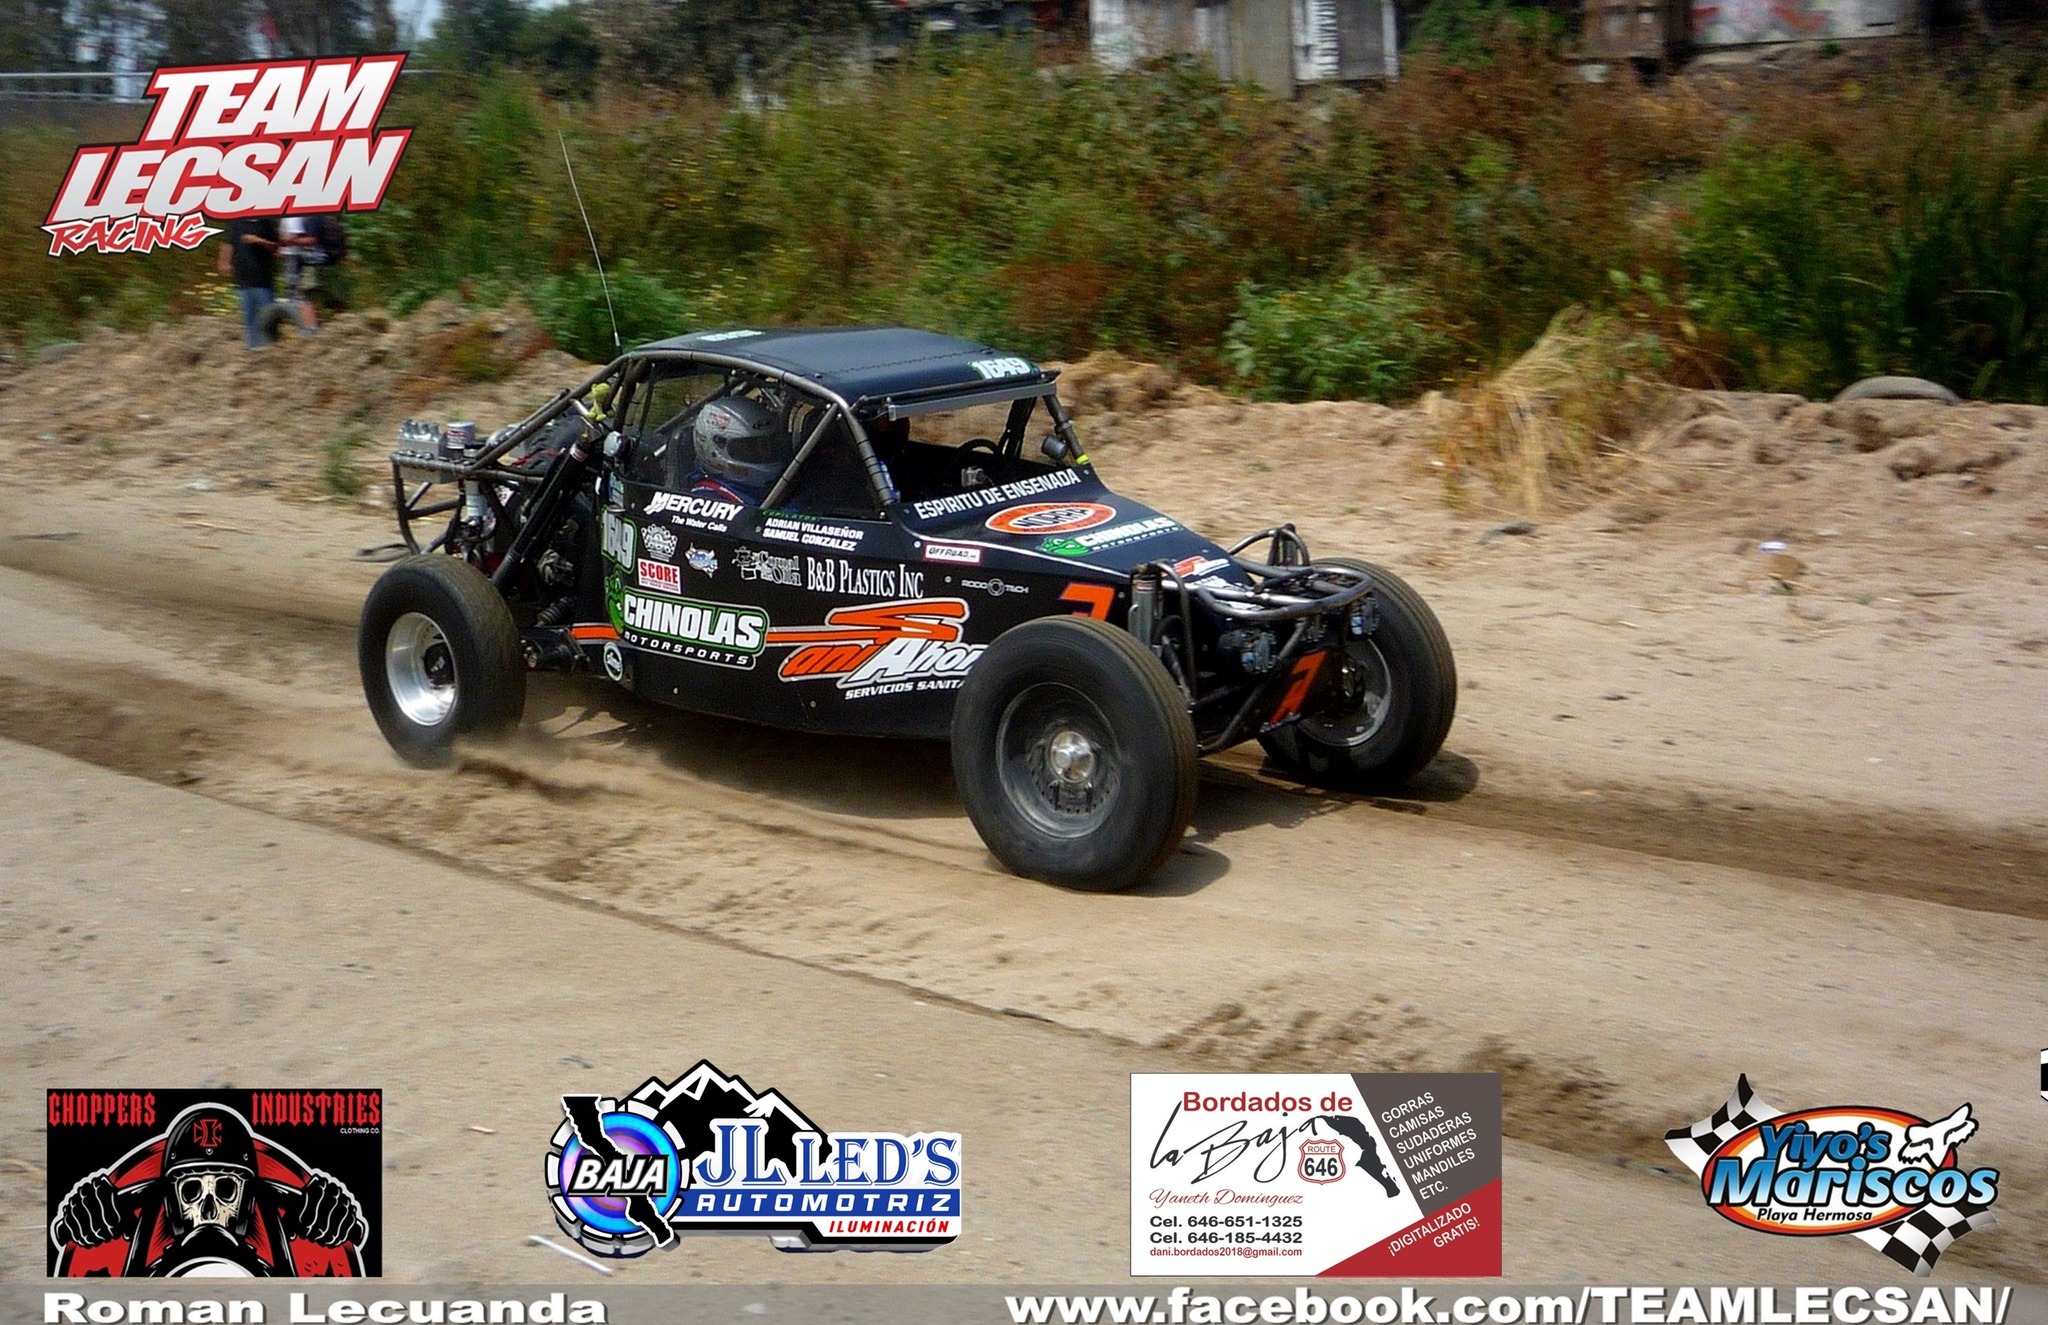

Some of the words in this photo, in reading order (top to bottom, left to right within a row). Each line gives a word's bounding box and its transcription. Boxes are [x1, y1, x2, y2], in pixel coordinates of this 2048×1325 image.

[971, 358, 1032, 379] 1649
[913, 494, 984, 520] ESPIRITU
[983, 487, 1002, 505] DE
[1000, 468, 1082, 500] ENSENADA
[643, 491, 743, 521] MERCURY
[671, 515, 685, 525] The
[707, 521, 728, 533] Calls
[765, 518, 801, 531] ADRIAN
[801, 522, 864, 540] VILLASEÑOR
[762, 528, 800, 542] SAMUEL
[801, 535, 858, 551] GONZALEZ
[640, 561, 679, 584] SCORE
[806, 556, 835, 593] B&B
[623, 593, 764, 649] CHINOLAS
[624, 631, 750, 665] MOTORSPORTS
[844, 682, 914, 700] SERVICIOS
